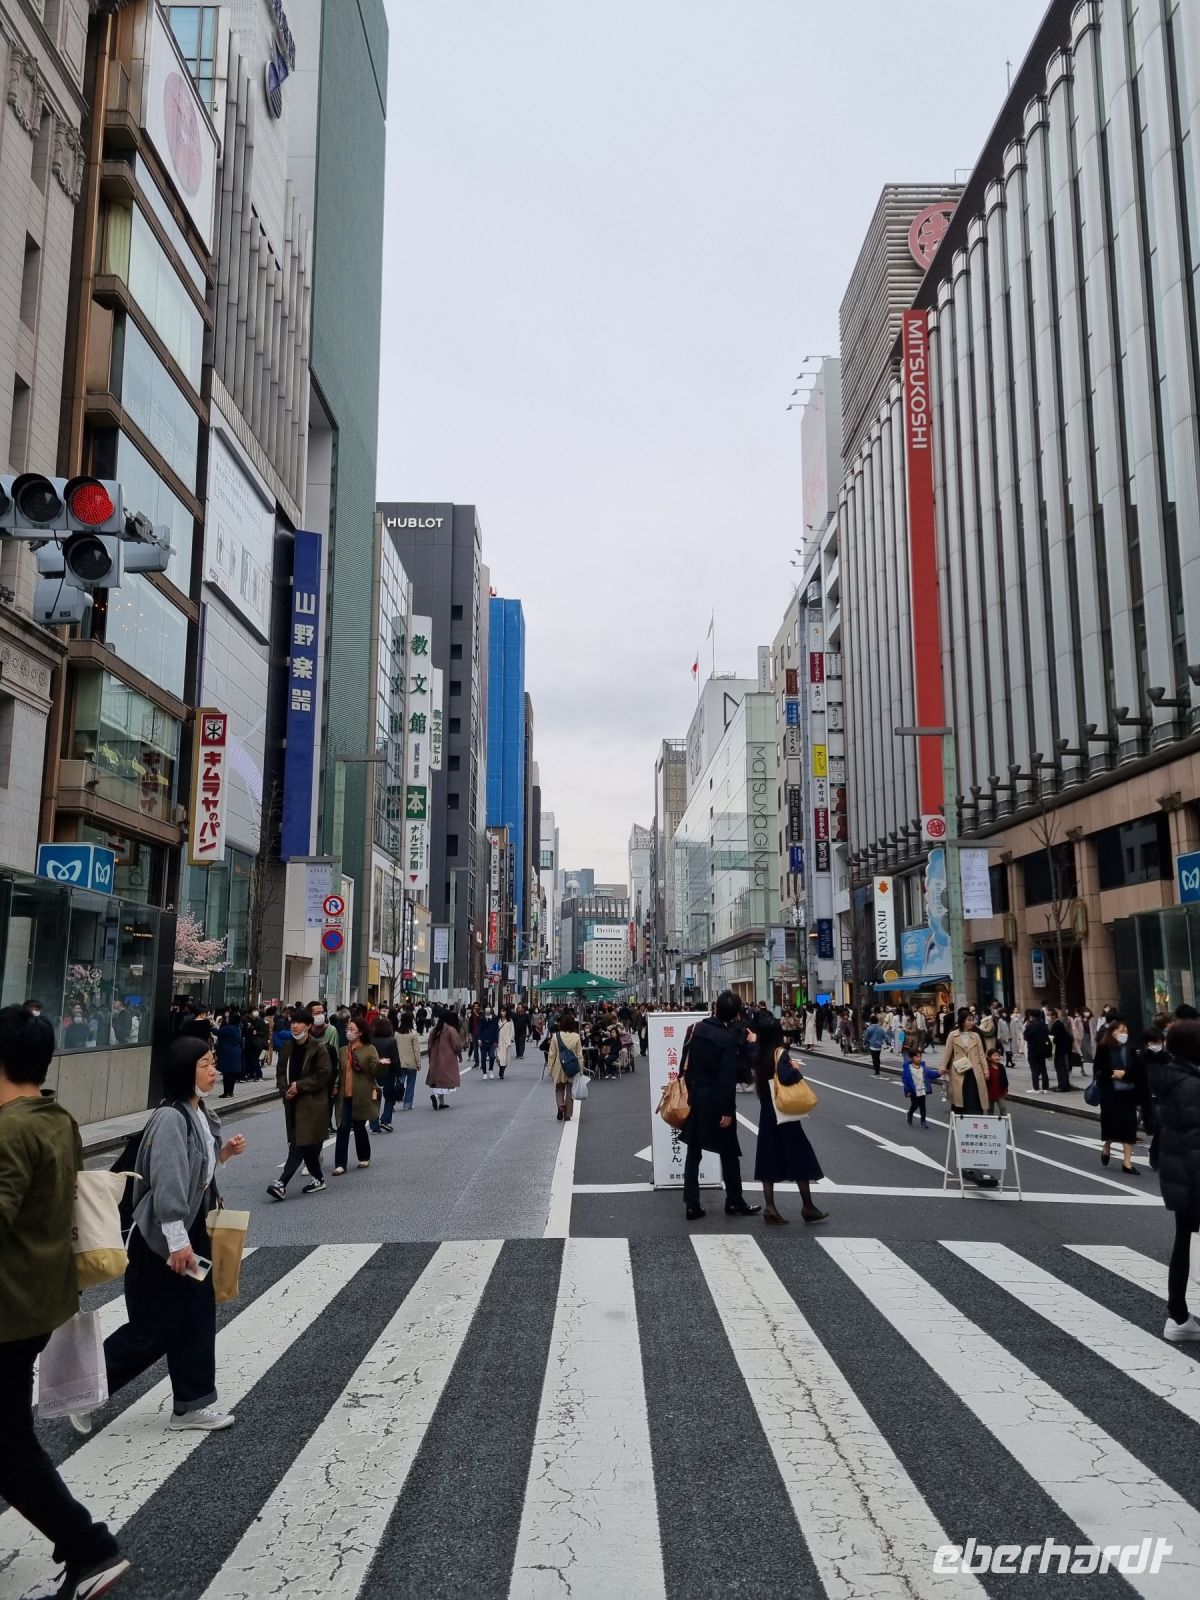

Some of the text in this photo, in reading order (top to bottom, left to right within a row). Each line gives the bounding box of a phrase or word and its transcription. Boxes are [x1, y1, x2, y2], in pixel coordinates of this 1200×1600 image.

[907, 319, 928, 449] MITSUKOSHI
[387, 517, 444, 529] HUBLOT
[291, 591, 316, 713] 山野楽器
[409, 634, 428, 735] 教文館
[198, 751, 222, 853] キムラヤのパン
[407, 791, 425, 814] 本
[409, 825, 420, 870] ナルニア国
